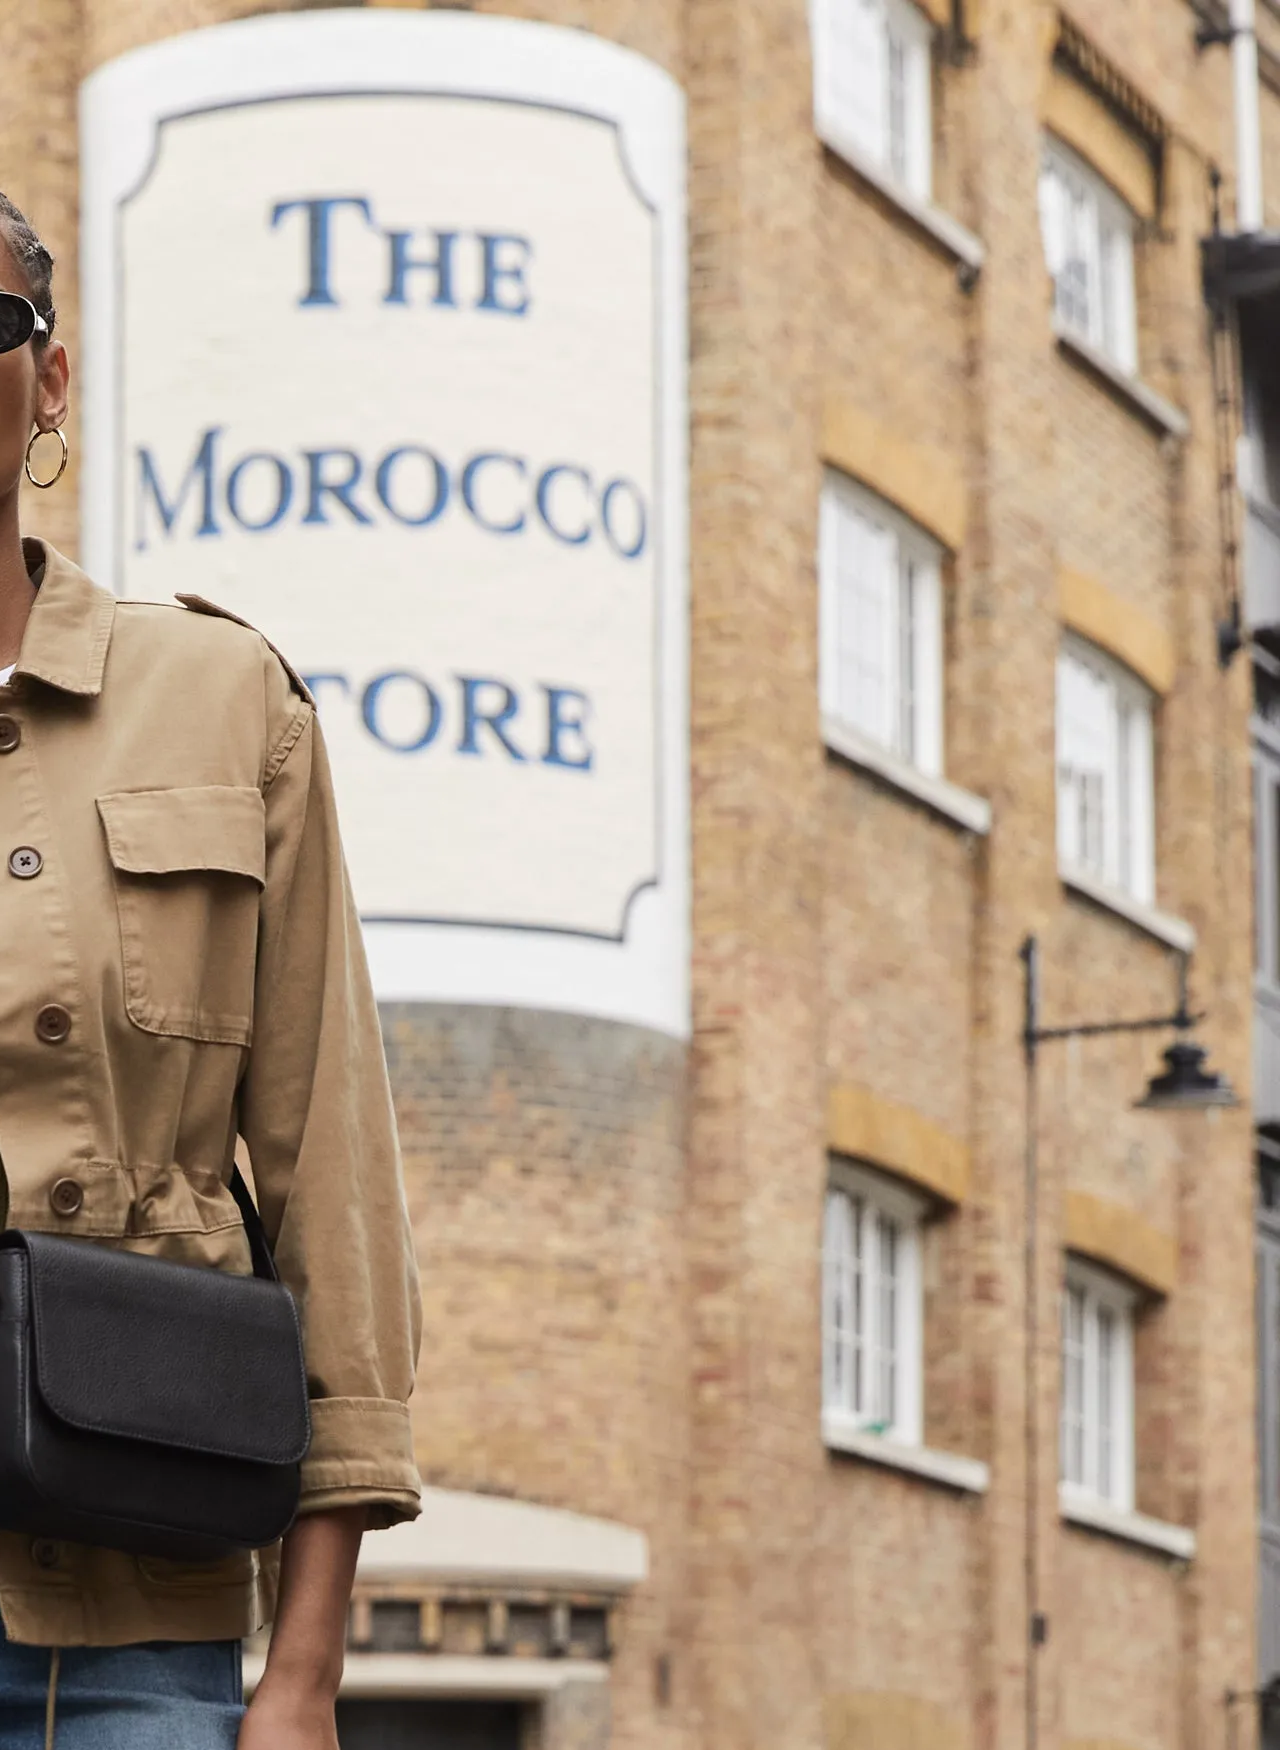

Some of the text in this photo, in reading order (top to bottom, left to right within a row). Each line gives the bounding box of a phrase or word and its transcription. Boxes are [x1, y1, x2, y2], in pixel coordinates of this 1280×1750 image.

[270, 193, 534, 317] THE
[133, 424, 647, 560] MOROCCO
[300, 668, 596, 772] ORE
